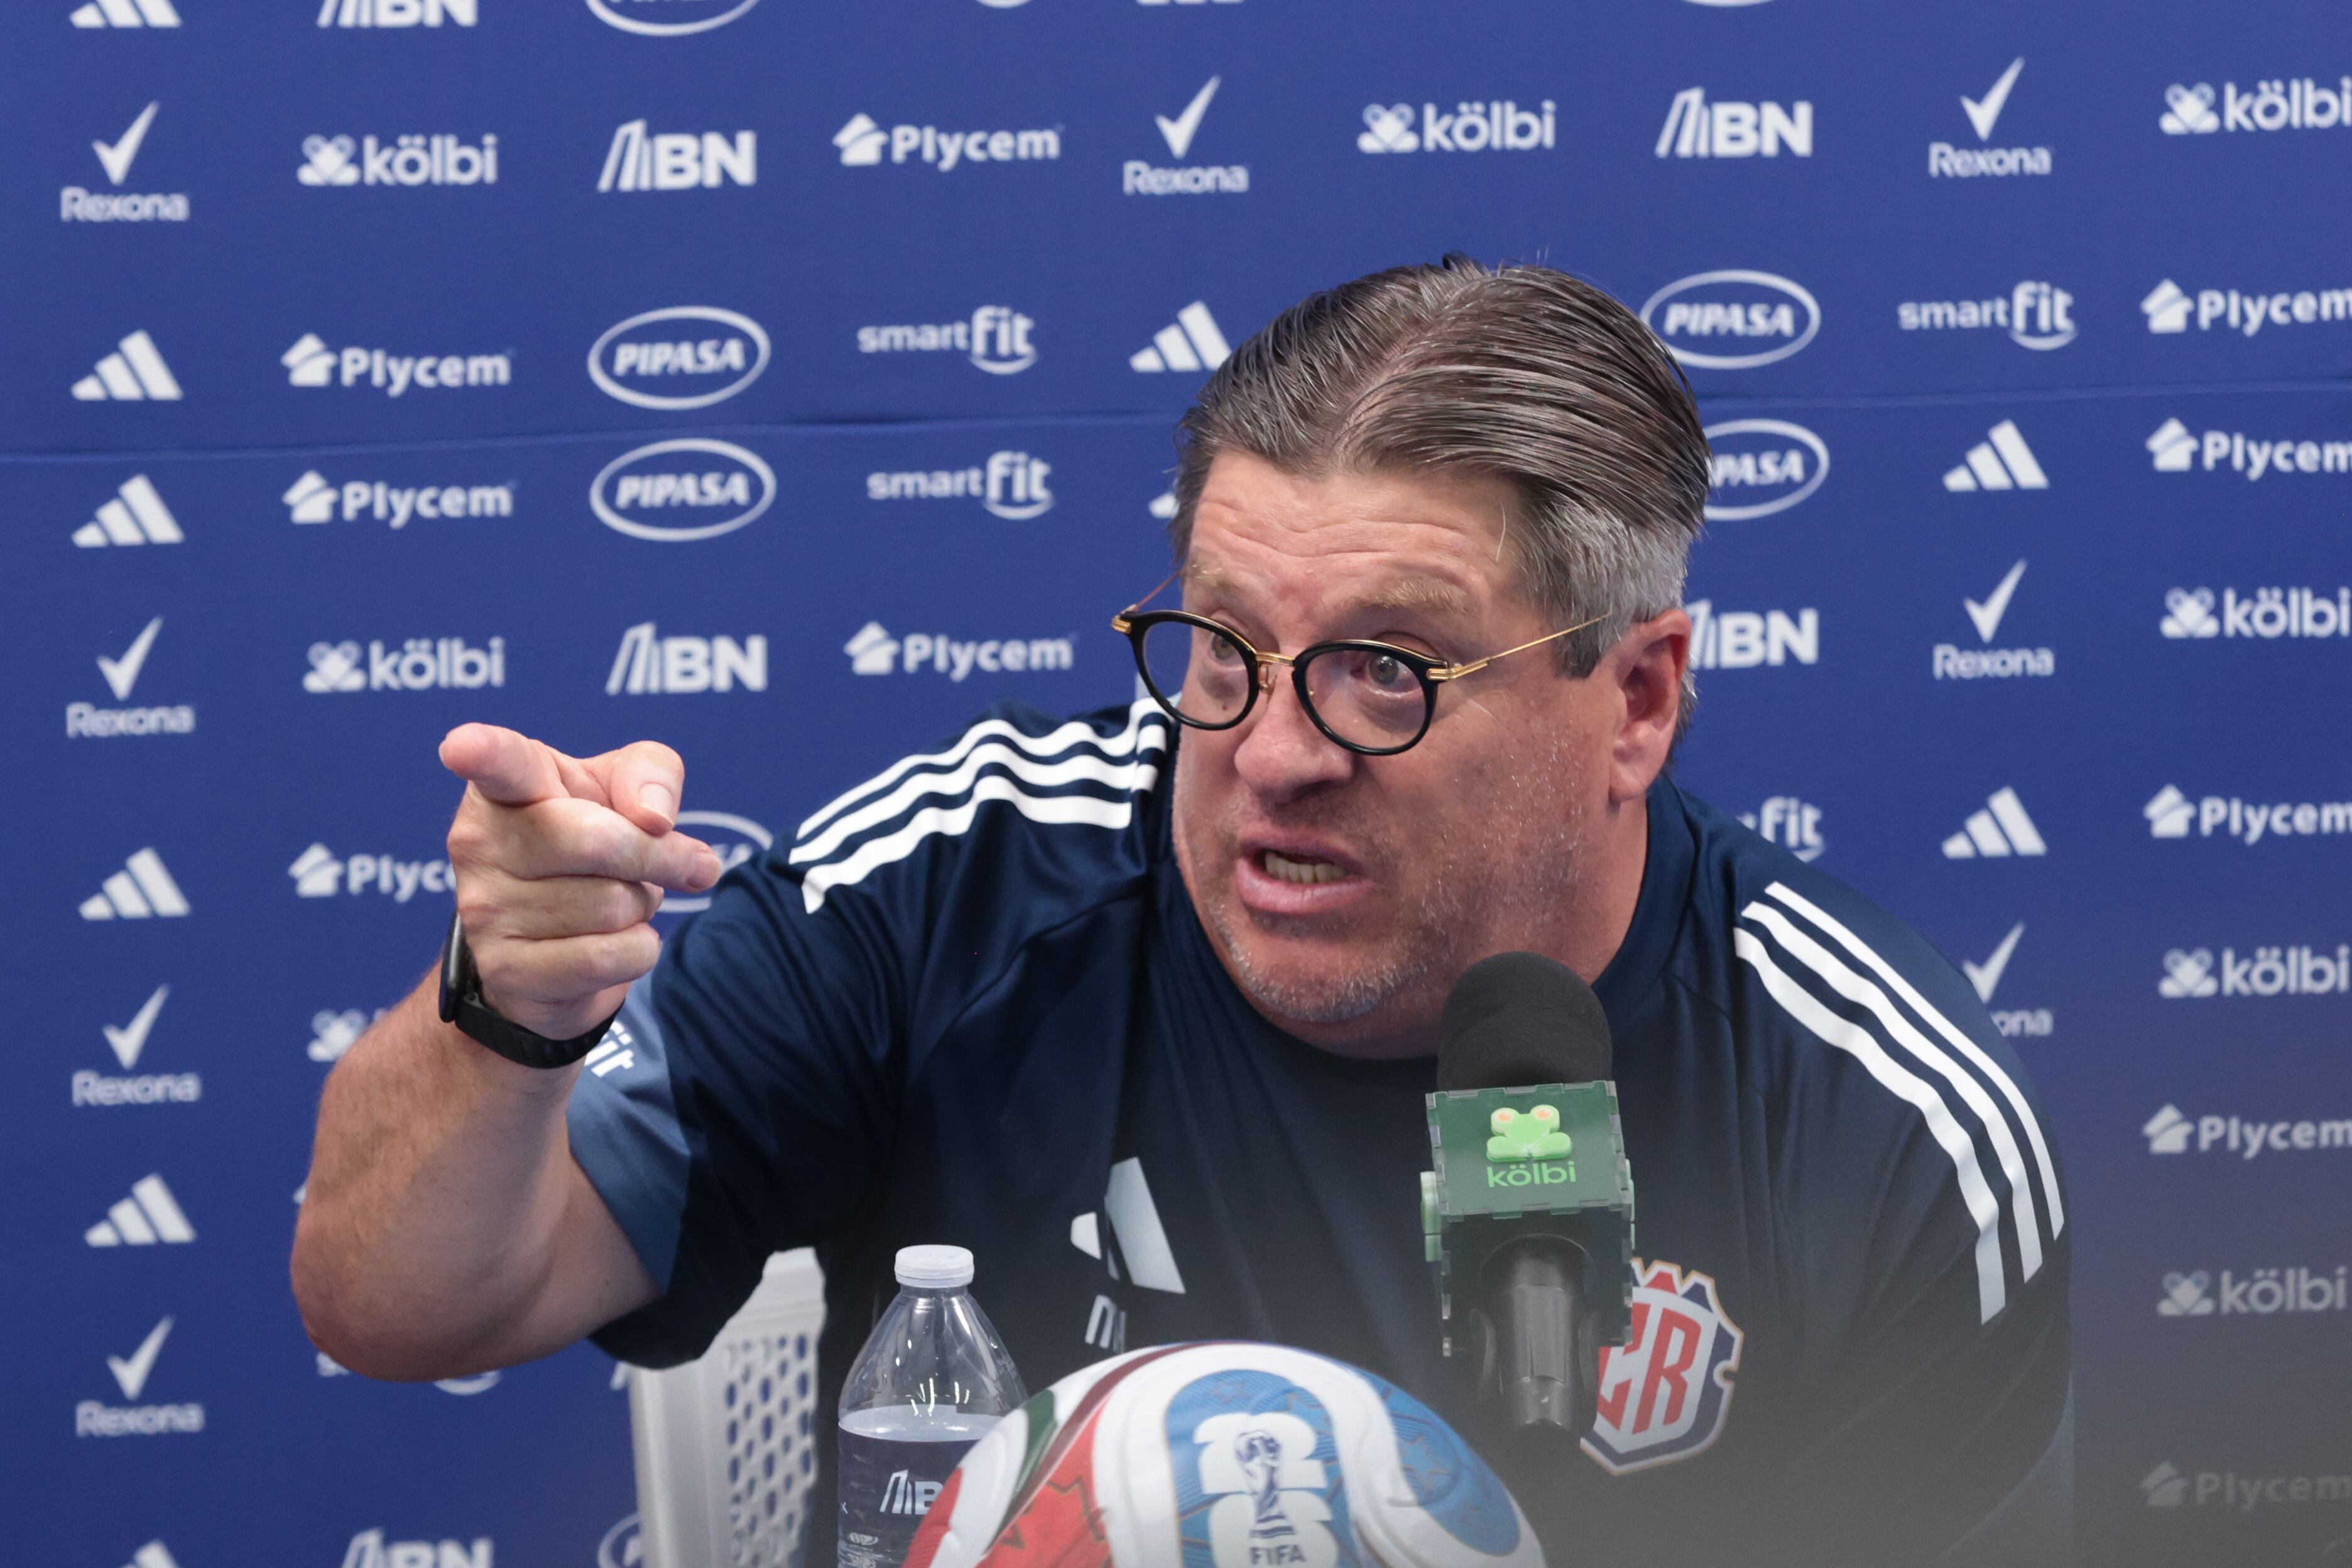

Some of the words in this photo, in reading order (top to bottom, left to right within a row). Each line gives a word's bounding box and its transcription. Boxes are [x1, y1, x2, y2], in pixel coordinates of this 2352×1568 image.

[1424, 101, 1555, 151] kölbi
[2224, 77, 2352, 131] kölbi
[364, 134, 496, 185] kölbi
[892, 125, 1059, 171] Plycem
[1929, 143, 2051, 177] Rexona
[1123, 161, 1248, 194] Rexona
[61, 187, 189, 221] Rexona
[1664, 304, 1794, 336] PIPASA
[2198, 289, 2352, 335] Plycem
[340, 347, 510, 396] Plycem
[614, 338, 744, 376] PIPASA
[2203, 432, 2352, 480] Plycem
[343, 482, 512, 528] Plycem
[616, 471, 748, 508] PIPASA
[2224, 588, 2350, 637] kölbi
[369, 638, 504, 689] kölbi
[904, 634, 1072, 681] Plycem
[1934, 645, 2054, 678] Rexona
[67, 702, 194, 737] Rexona
[2200, 797, 2352, 844] Plycem
[347, 854, 457, 903] Plyc
[2223, 945, 2349, 995] kölbi
[1991, 1010, 2052, 1037] ona
[72, 1070, 200, 1105] Rexona
[1487, 1160, 1576, 1187] kölbi
[2221, 1266, 2346, 1314] kölbi
[76, 1401, 204, 1435] Rexona
[1249, 1544, 1306, 1565] FIFA
